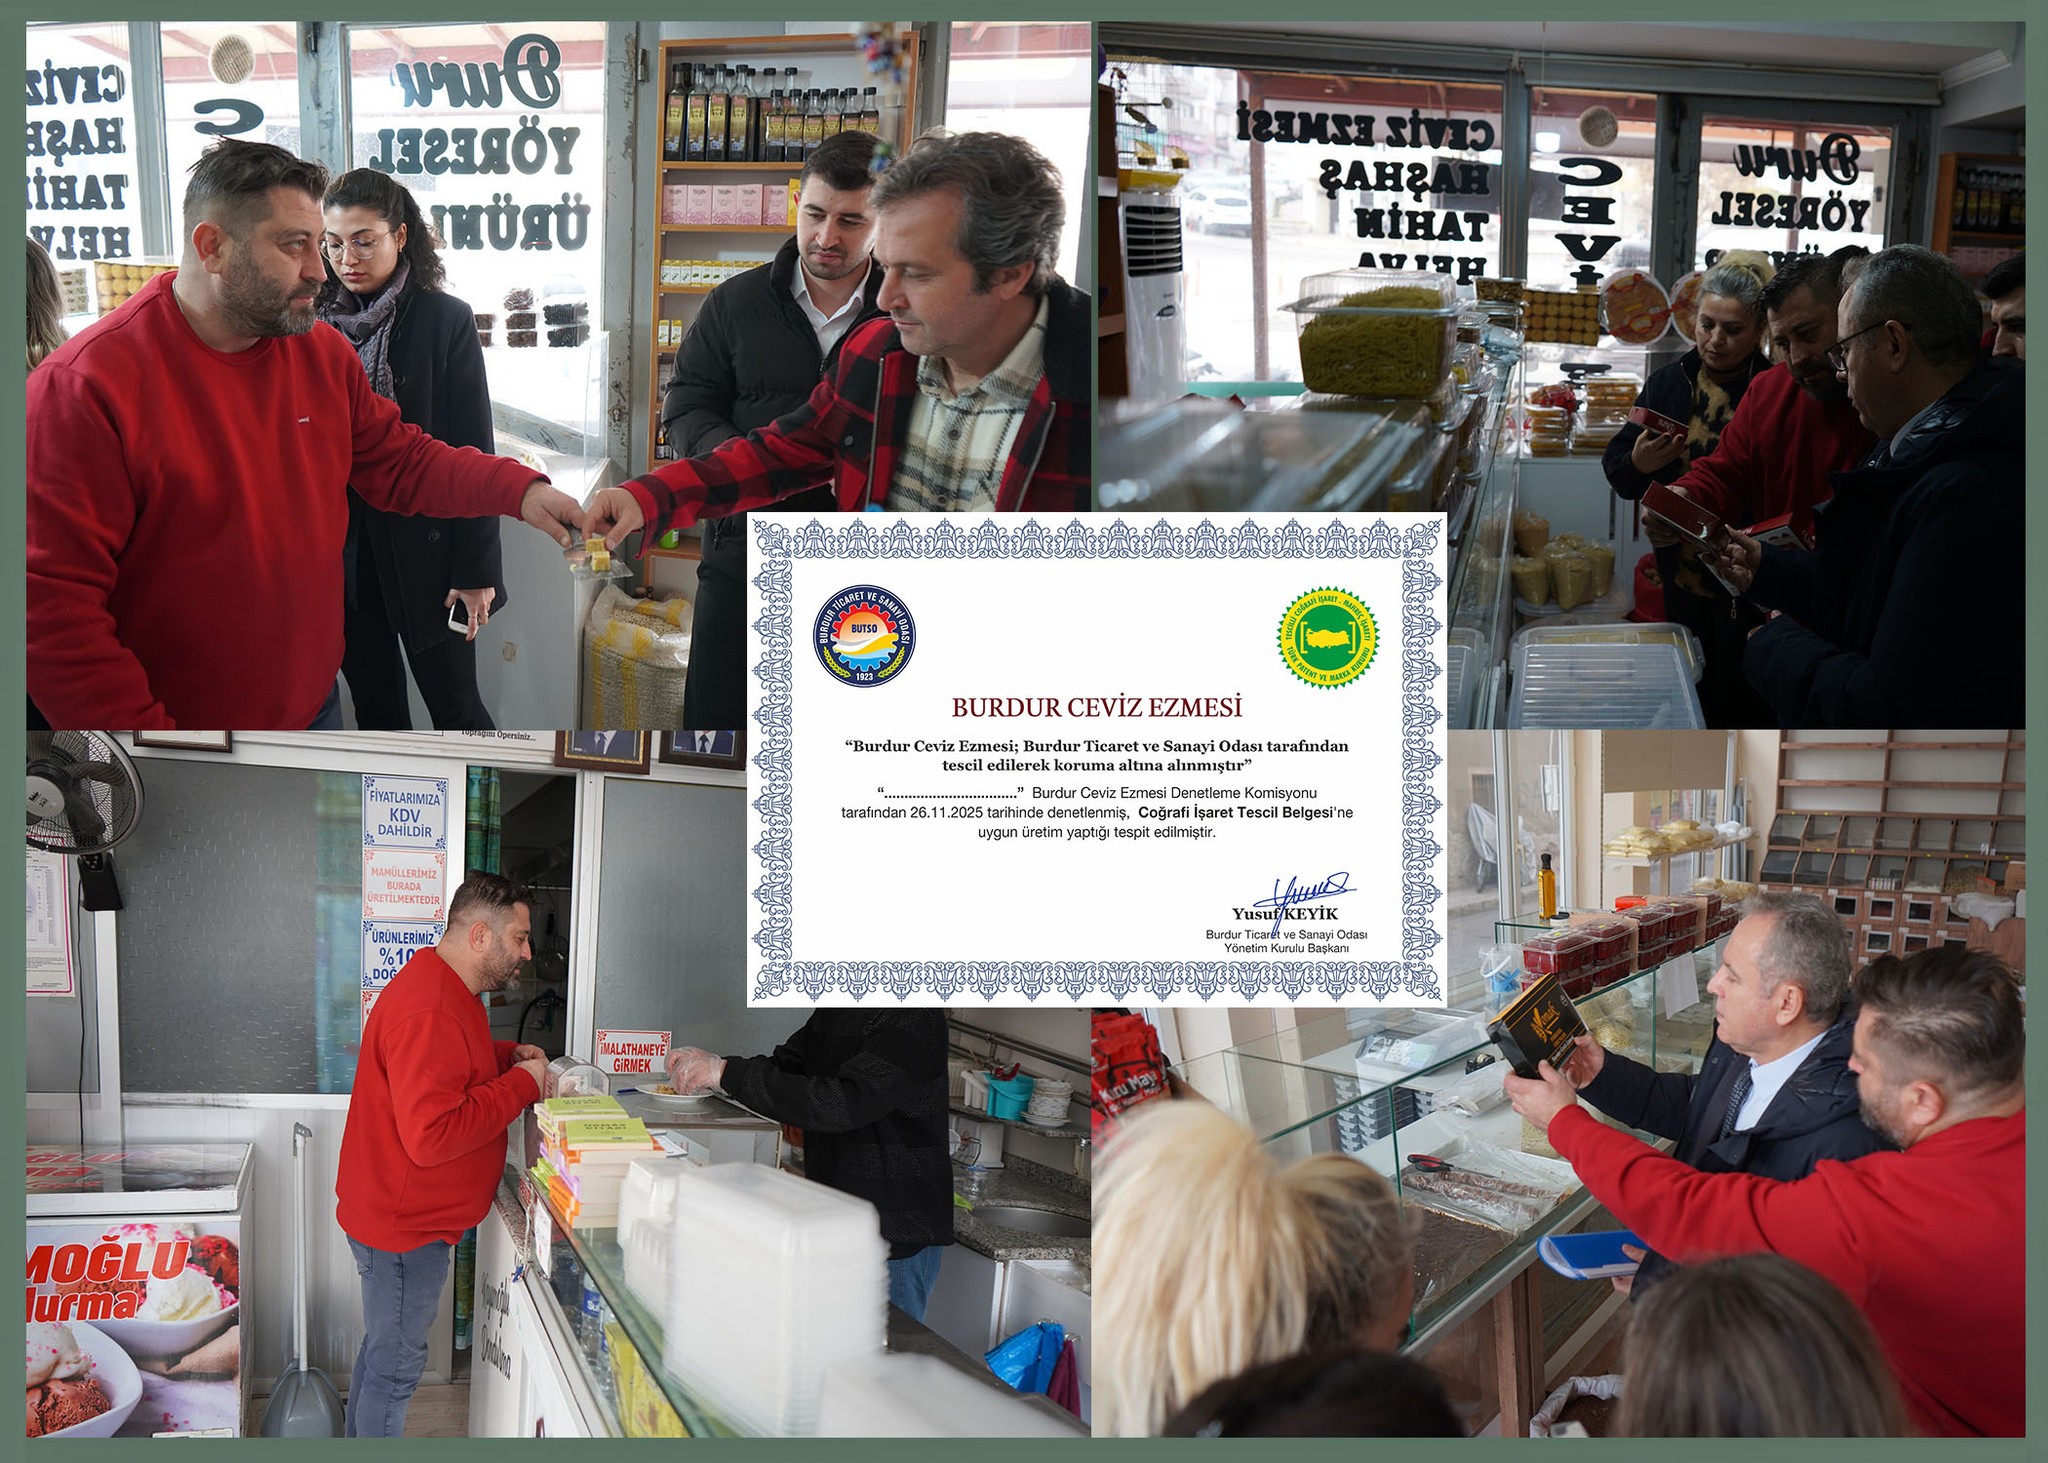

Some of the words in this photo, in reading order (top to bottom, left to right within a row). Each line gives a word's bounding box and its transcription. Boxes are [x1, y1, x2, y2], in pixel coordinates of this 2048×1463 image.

[820, 609, 836, 644] BURDUR
[832, 591, 865, 611] TİCARET
[867, 592, 878, 601] VE
[879, 595, 905, 619] SANAYİ
[898, 618, 910, 645] ODASI
[851, 624, 878, 633] BUTSO
[1287, 646, 1299, 664] TÜRK
[1296, 662, 1317, 679] PATENT
[1330, 669, 1351, 681] MARKA
[1350, 647, 1370, 672] KURUMU
[856, 673, 874, 681] 1923
[952, 697, 1062, 718] BURDUR
[1067, 692, 1143, 718] CEVİZ
[1148, 692, 1243, 718] EZMESİ
[845, 739, 911, 753] “Burdur
[914, 739, 955, 753] Ceviz
[959, 739, 1019, 755] Ezmesi;
[1023, 739, 1081, 753] Burdur
[1084, 739, 1140, 753] Ticaret
[1143, 743, 1160, 753] ve
[1164, 739, 1216, 755] Sanayi
[1219, 739, 1263, 753] Odası
[1267, 739, 1349, 753] tarafından
[942, 758, 983, 772] tescil
[987, 758, 1051, 772] edilerek
[1054, 758, 1115, 772] koruma
[1118, 758, 1163, 772] altına
[1167, 758, 1252, 775] alınmıştır”
[369, 788, 441, 806] FİYATLARIMIZA
[1033, 786, 1077, 799] Burdur
[1081, 786, 1117, 799] Ceviz
[1120, 786, 1167, 799] Ezmesi
[1171, 786, 1241, 799] Denetleme
[1245, 786, 1317, 802] Komisyonu
[389, 808, 421, 823] KDV
[841, 806, 907, 819] tarafından
[910, 806, 984, 819] 26.11.2025
[987, 806, 1044, 819] tarihinde
[1047, 806, 1130, 821] denetlenmiş,
[1138, 806, 1190, 822] Coğrafi
[1194, 803, 1234, 821] İşaret
[1237, 806, 1278, 819] Tescil
[1282, 806, 1354, 822] Belgesi'ne
[378, 823, 432, 838] DAHİLDİR
[978, 828, 1018, 841] uygun
[1022, 826, 1063, 839] üretim
[1066, 825, 1110, 842] yaptığı
[1113, 826, 1151, 842] tespit
[1154, 825, 1216, 841] edilmiştir.
[371, 866, 437, 879] MAMÜLLERİMİZ
[387, 881, 421, 891] BURADA
[367, 892, 440, 905] ÜRETİLMEKTEDİR
[1232, 907, 1281, 920] Yusuf
[1284, 905, 1338, 920] KEYİK
[372, 928, 434, 945] ÜRÜNLERİMİZ
[1206, 929, 1242, 940] Burdur
[1245, 929, 1281, 940] Ticaret
[1284, 931, 1296, 940] ve
[1299, 929, 1334, 942] Sanayi
[1336, 929, 1368, 940] Odası
[1224, 943, 1268, 953] Yönetim
[1271, 943, 1304, 953] Kurulu
[1307, 943, 1350, 955] Başkanı
[26, 1234, 190, 1284] MOĞLU
